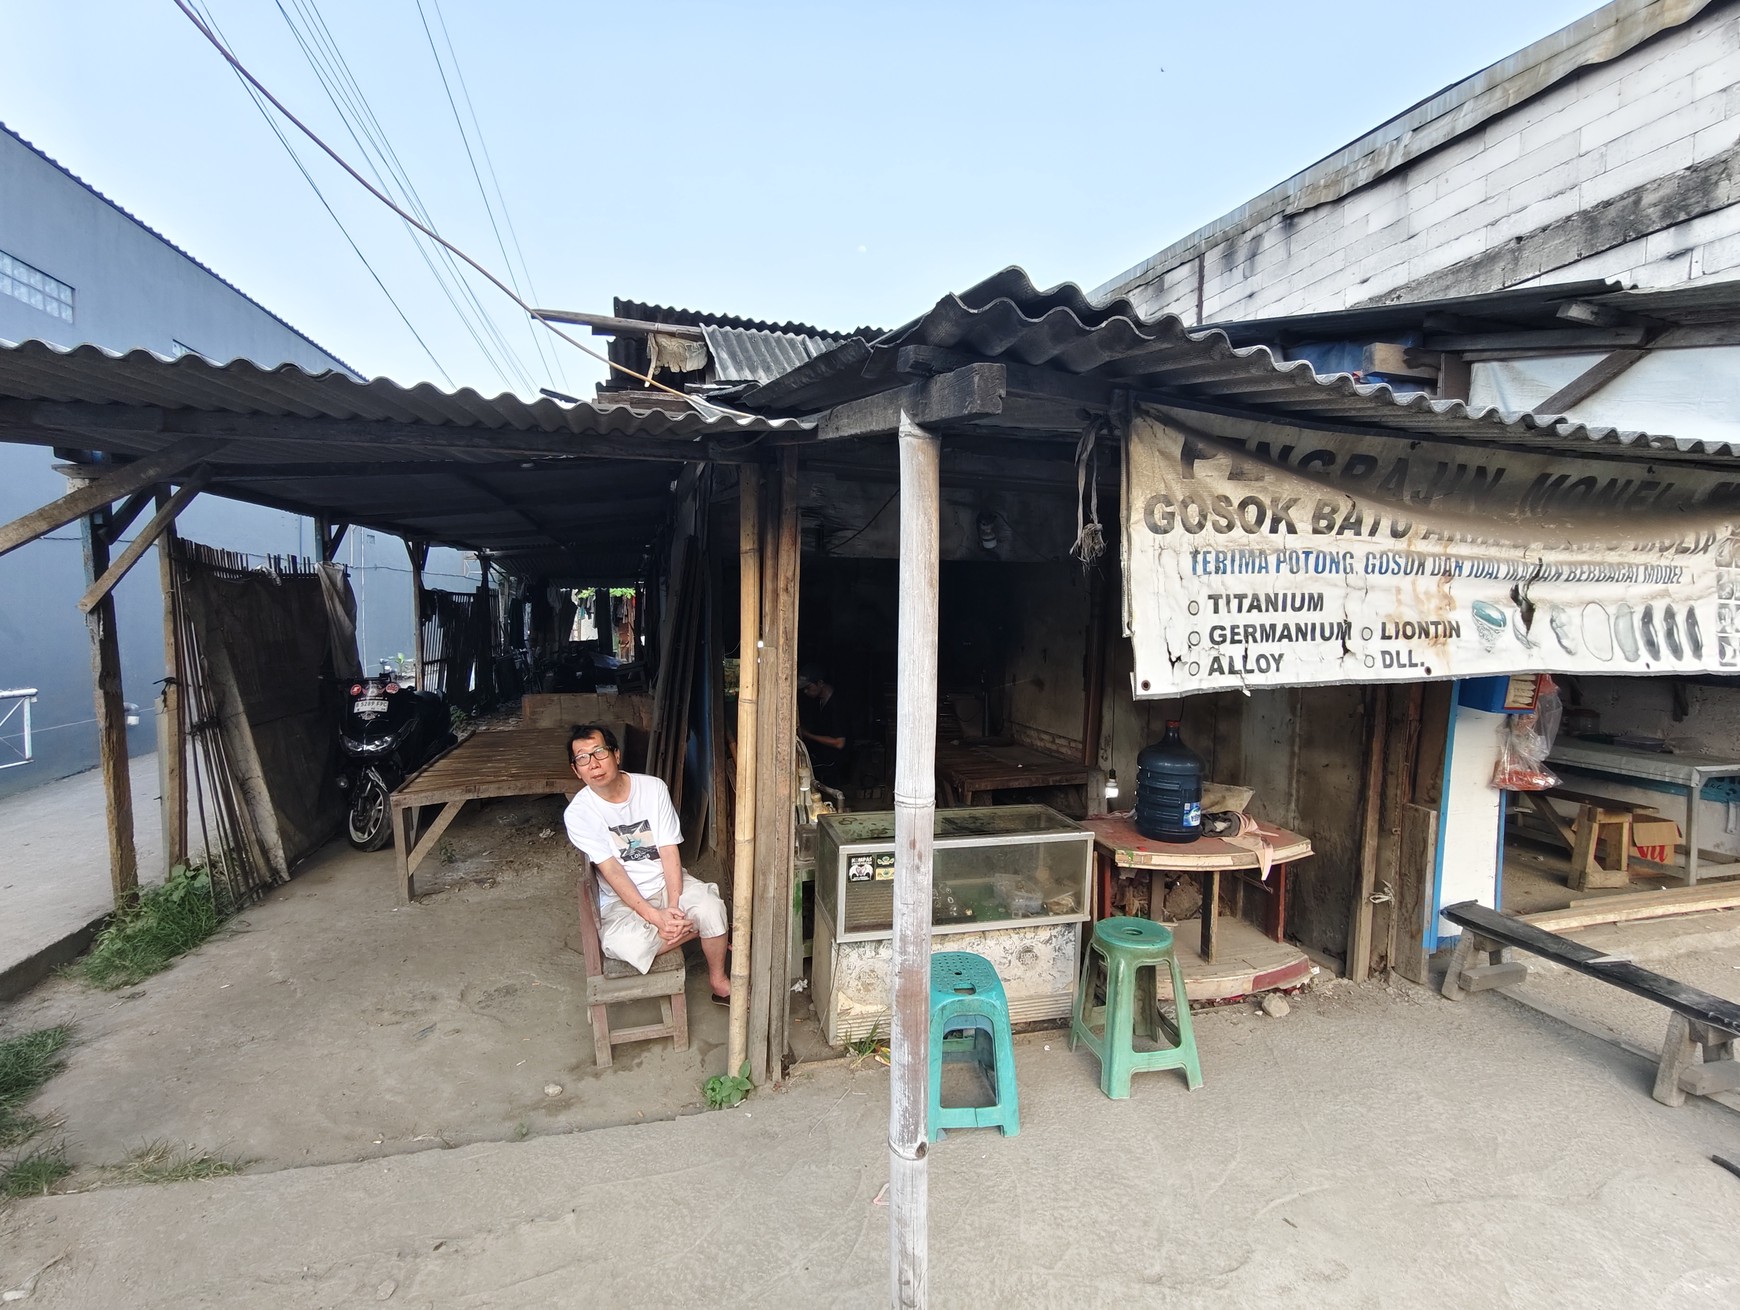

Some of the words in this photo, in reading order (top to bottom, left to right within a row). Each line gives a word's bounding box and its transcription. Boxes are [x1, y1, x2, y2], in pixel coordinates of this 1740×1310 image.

[1144, 494, 1301, 535] GOSOK
[1190, 549, 1269, 575] TERIMA
[1364, 551, 1427, 577] GOSOK
[1430, 554, 1464, 578] DAN
[1467, 557, 1500, 580] JUAL
[1642, 564, 1683, 585] MODEL
[1208, 593, 1324, 613] TITANIUM
[1209, 622, 1352, 645] GERMANIUM
[1381, 620, 1461, 641] LIONTIN
[1208, 653, 1284, 676] ALLOY
[1381, 650, 1425, 669] DLL.
